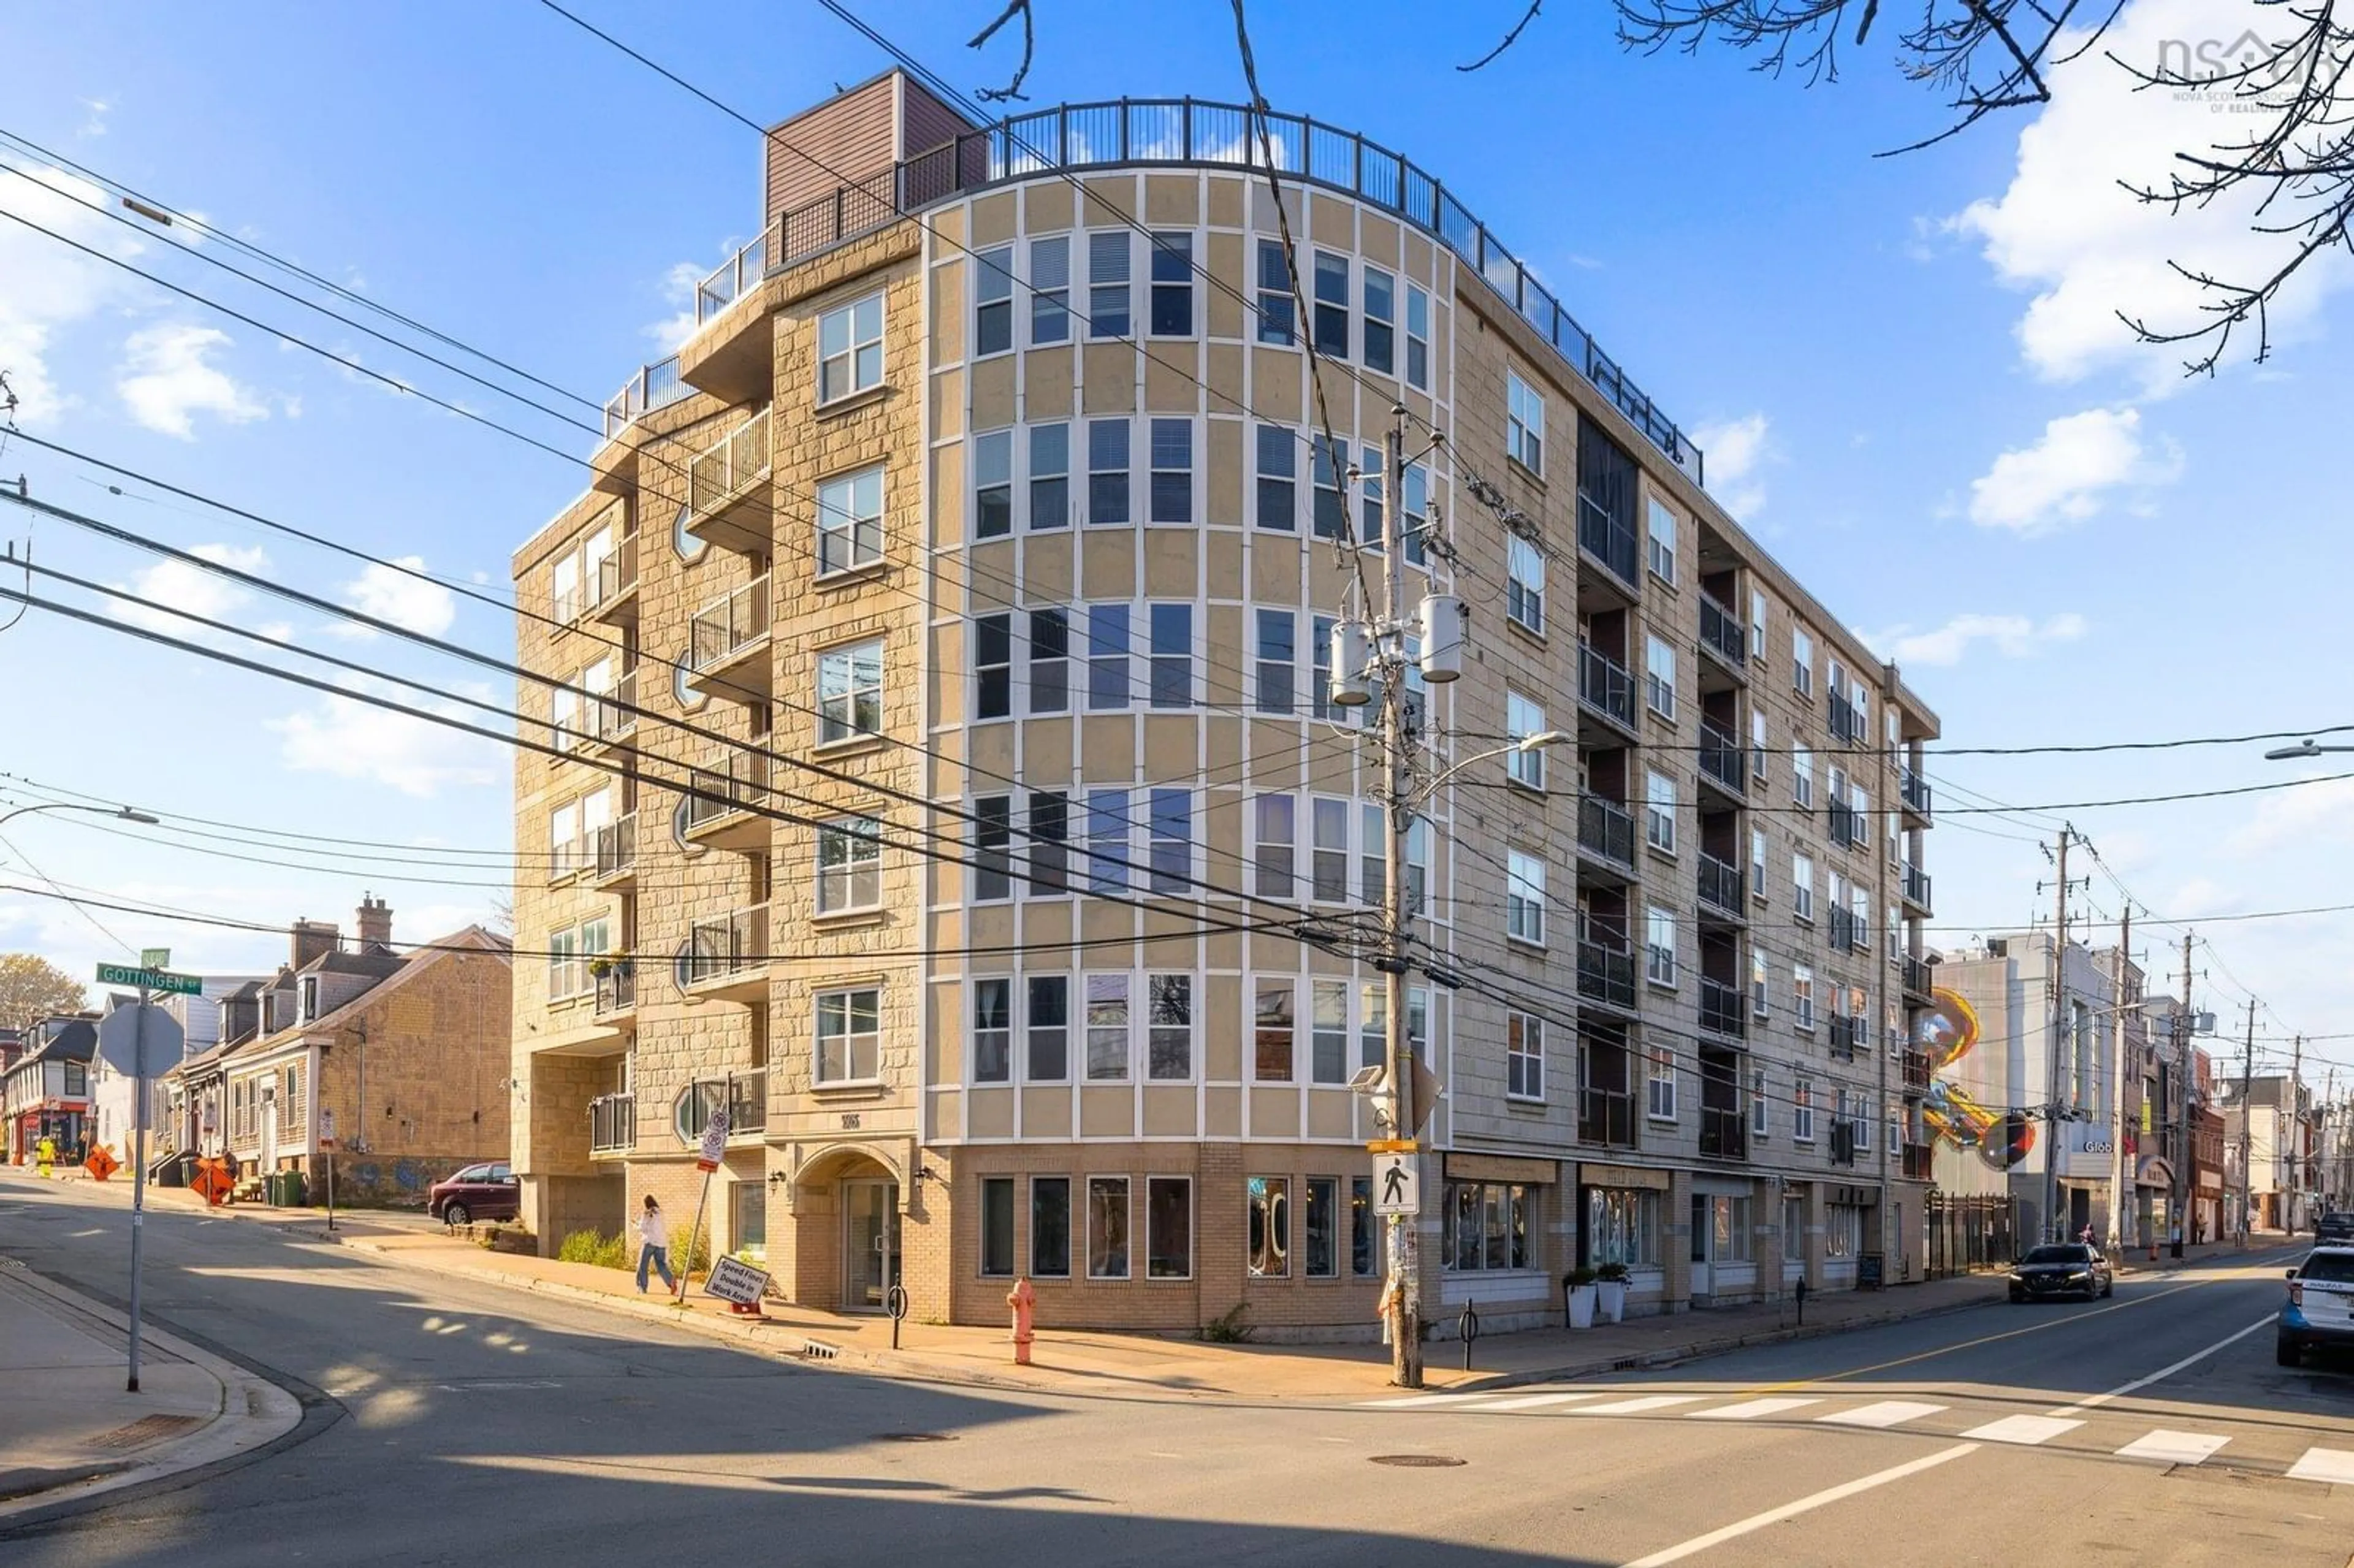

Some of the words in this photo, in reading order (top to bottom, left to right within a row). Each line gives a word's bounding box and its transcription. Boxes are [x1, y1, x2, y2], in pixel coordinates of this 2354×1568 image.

[104, 967, 184, 990] GOTTINGEN
[2085, 1141, 2112, 1153] Glob
[721, 1260, 745, 1276] Speed
[745, 1269, 763, 1284] Fines
[712, 1282, 731, 1296] Work
[719, 1273, 747, 1289] Double
